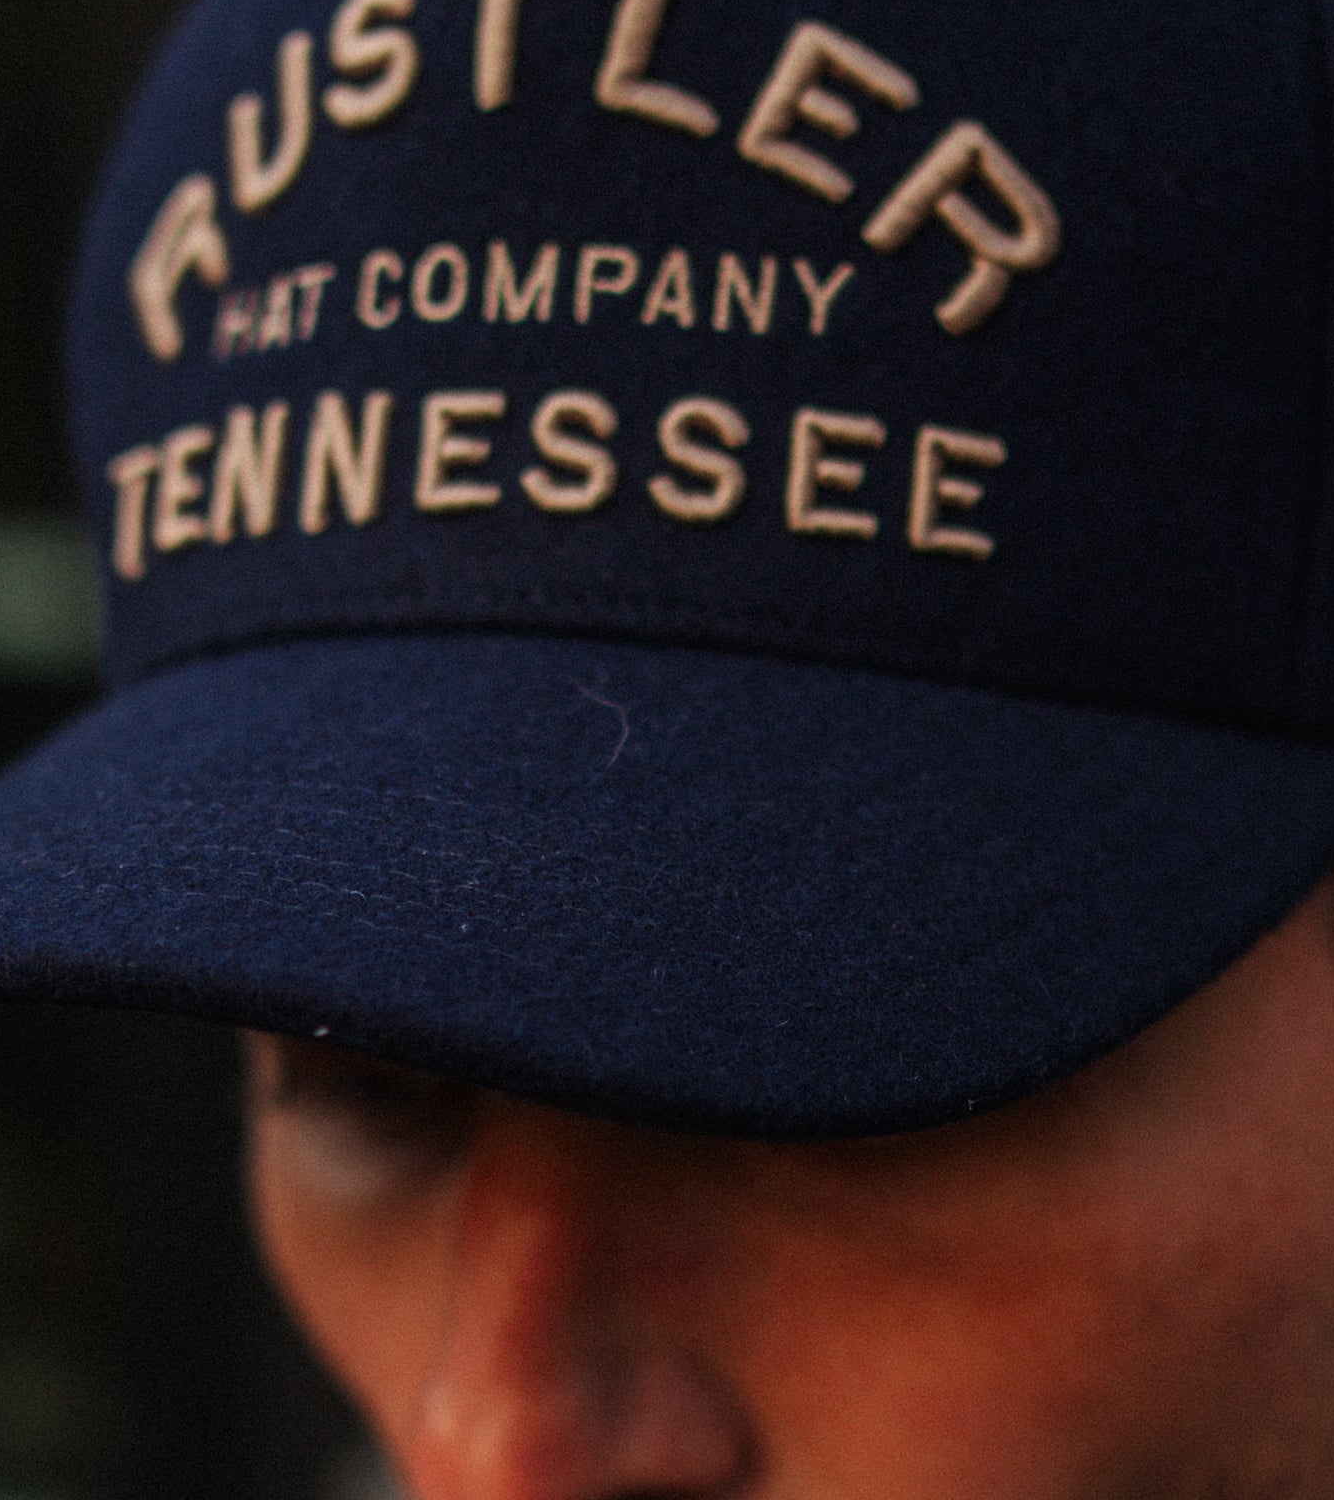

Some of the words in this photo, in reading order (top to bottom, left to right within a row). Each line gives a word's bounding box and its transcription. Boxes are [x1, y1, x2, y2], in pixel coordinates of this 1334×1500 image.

[214, 261, 337, 362] HAT
[355, 240, 856, 336] COMPANY
[106, 391, 1008, 580] TENNESSEE
